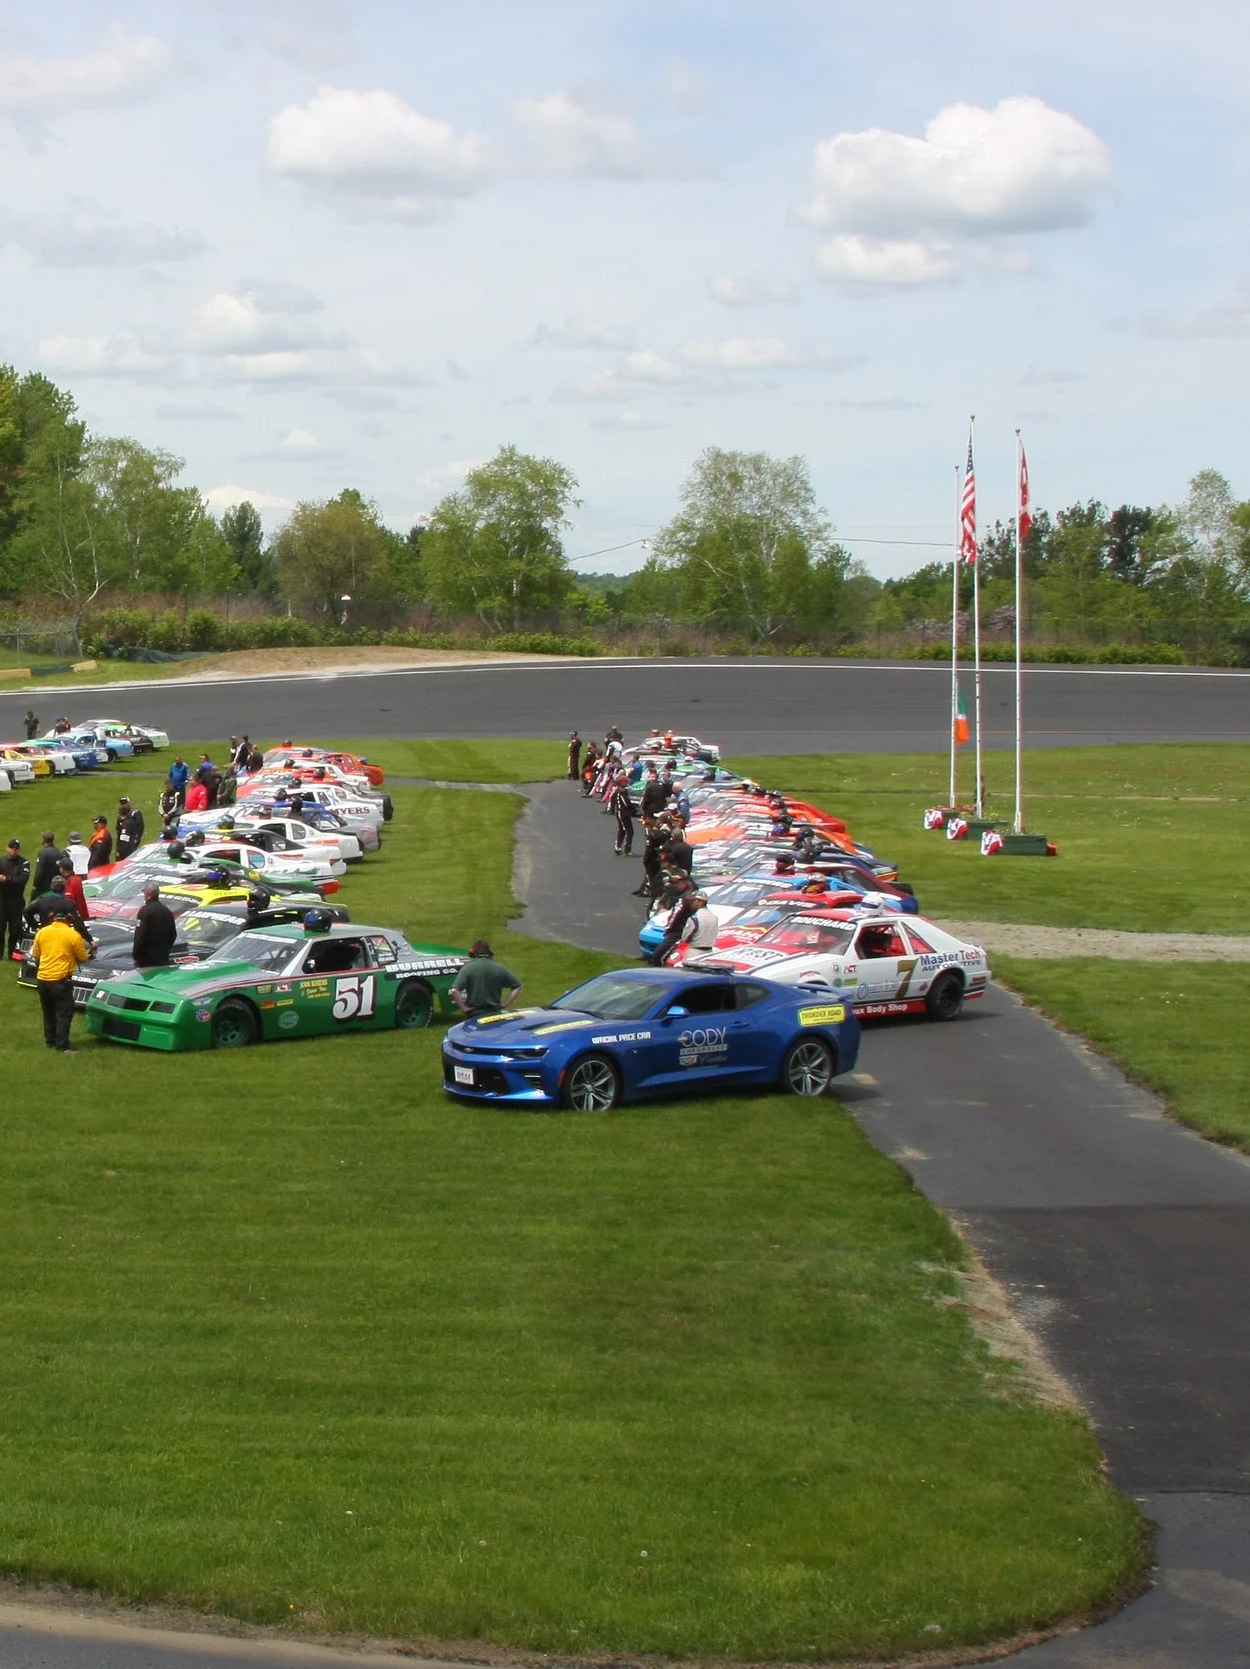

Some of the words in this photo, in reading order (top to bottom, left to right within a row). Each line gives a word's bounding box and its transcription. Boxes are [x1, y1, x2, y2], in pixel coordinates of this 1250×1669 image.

[330, 807, 370, 815] MYERS
[791, 915, 857, 932] BOUCHARD
[385, 958, 465, 973] BURRELL
[921, 959, 982, 972] AUTOMOTIVE
[395, 970, 441, 979] ROOFING
[895, 958, 919, 999] 7
[332, 975, 374, 1019] 51
[866, 1006, 886, 1014] Body
[888, 1003, 908, 1012] Shop
[591, 1035, 618, 1044] OFFICIAL
[619, 1033, 636, 1042] PACE
[636, 1031, 651, 1039] CAR
[680, 1027, 726, 1048] CODY
